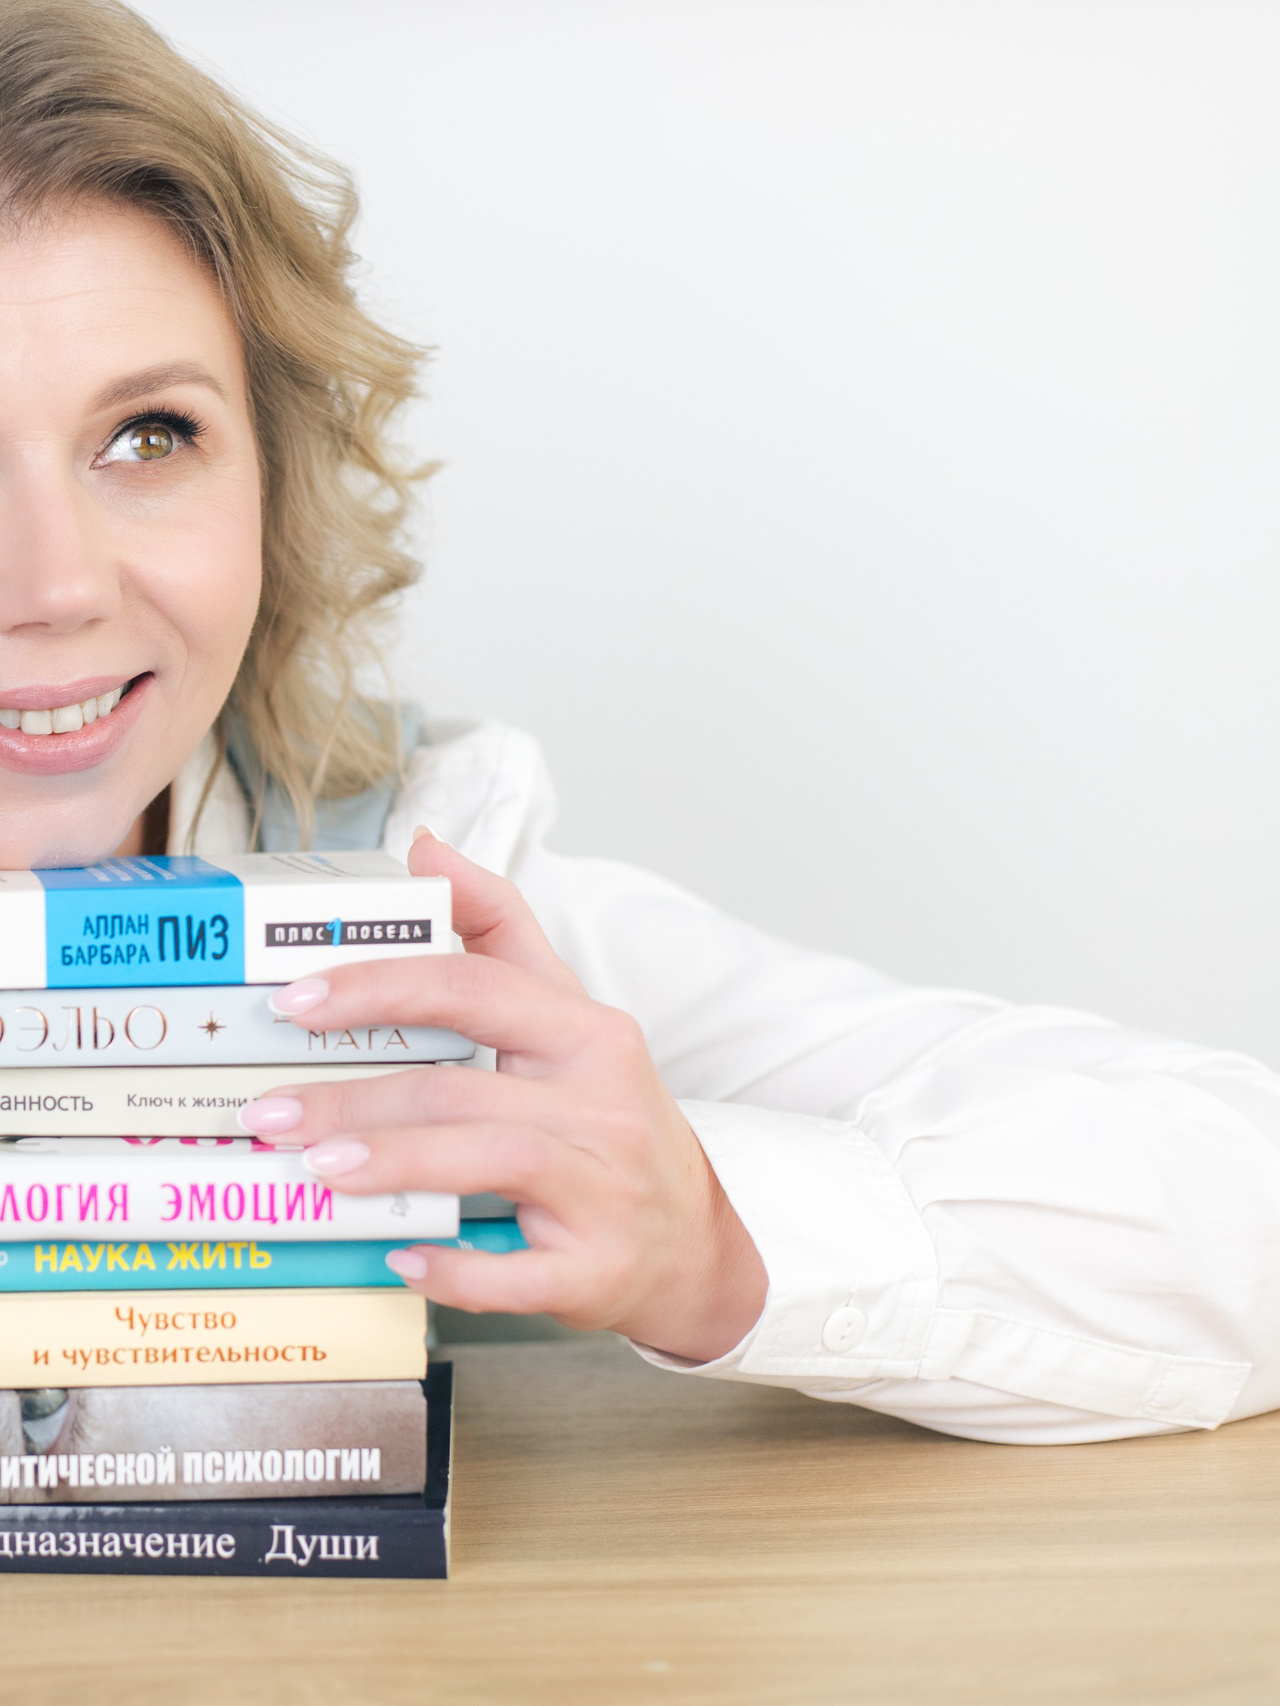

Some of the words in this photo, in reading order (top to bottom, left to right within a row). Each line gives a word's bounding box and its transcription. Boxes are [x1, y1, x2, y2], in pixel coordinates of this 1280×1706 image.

[82, 913, 150, 940] АЛЛАН
[158, 913, 230, 962] ПИЗ
[274, 926, 325, 944] ПЛЮС
[346, 924, 423, 940] ПОБЕДА
[61, 942, 151, 967] БАРБАРА
[307, 1028, 410, 1051] МАГА
[126, 1093, 173, 1108] Ключ
[34, 1244, 157, 1273] НАУКА
[166, 1241, 273, 1271] ЖИТЬ
[114, 1306, 238, 1337] Чувство
[32, 1348, 50, 1366] и
[62, 1344, 328, 1371] чувствительность
[182, 1447, 382, 1484] ПСИХОЛОГИИ
[265, 1524, 380, 1567] Души
